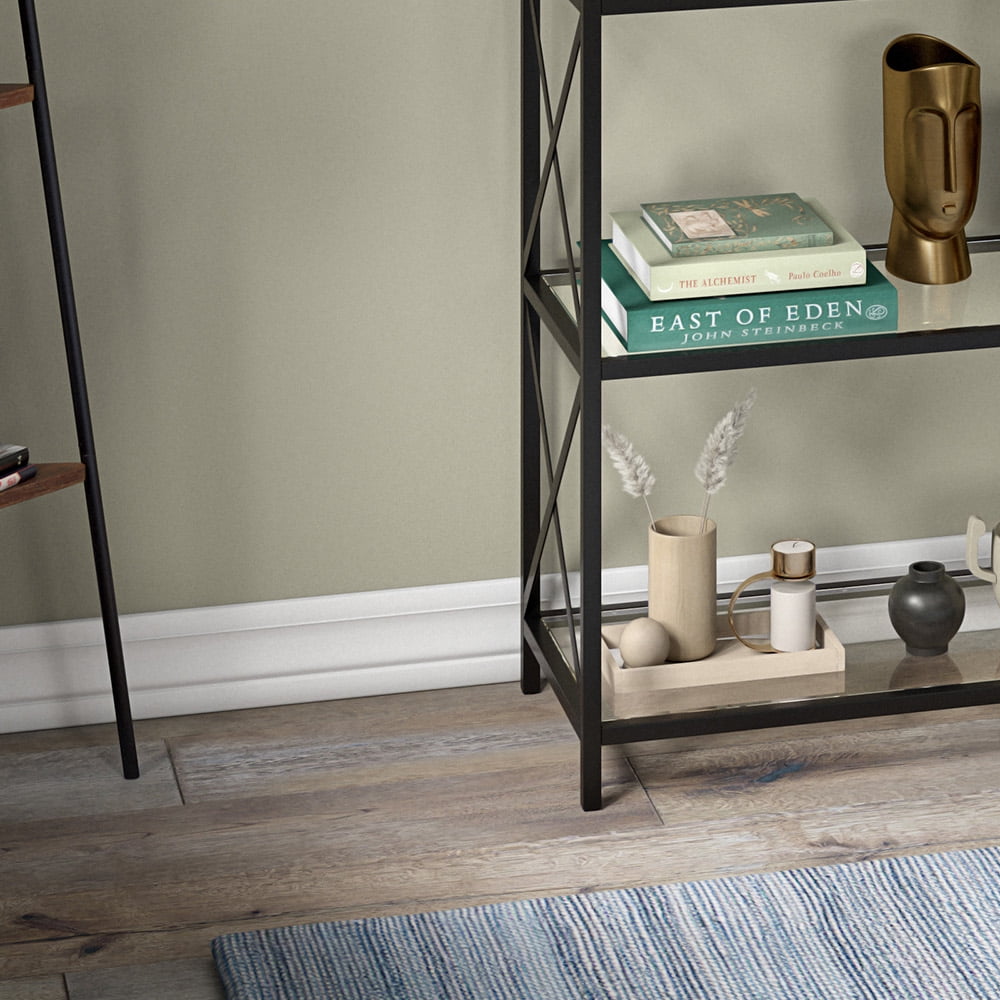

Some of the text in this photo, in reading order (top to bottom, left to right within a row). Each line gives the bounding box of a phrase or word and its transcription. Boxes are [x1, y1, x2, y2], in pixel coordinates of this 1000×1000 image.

[679, 275, 757, 289] THE ALCHEMIST
[788, 269, 841, 281] Paulo Coelho
[650, 300, 863, 333] EAST OF EDEN
[682, 321, 845, 344] JOHN STEINBECK
